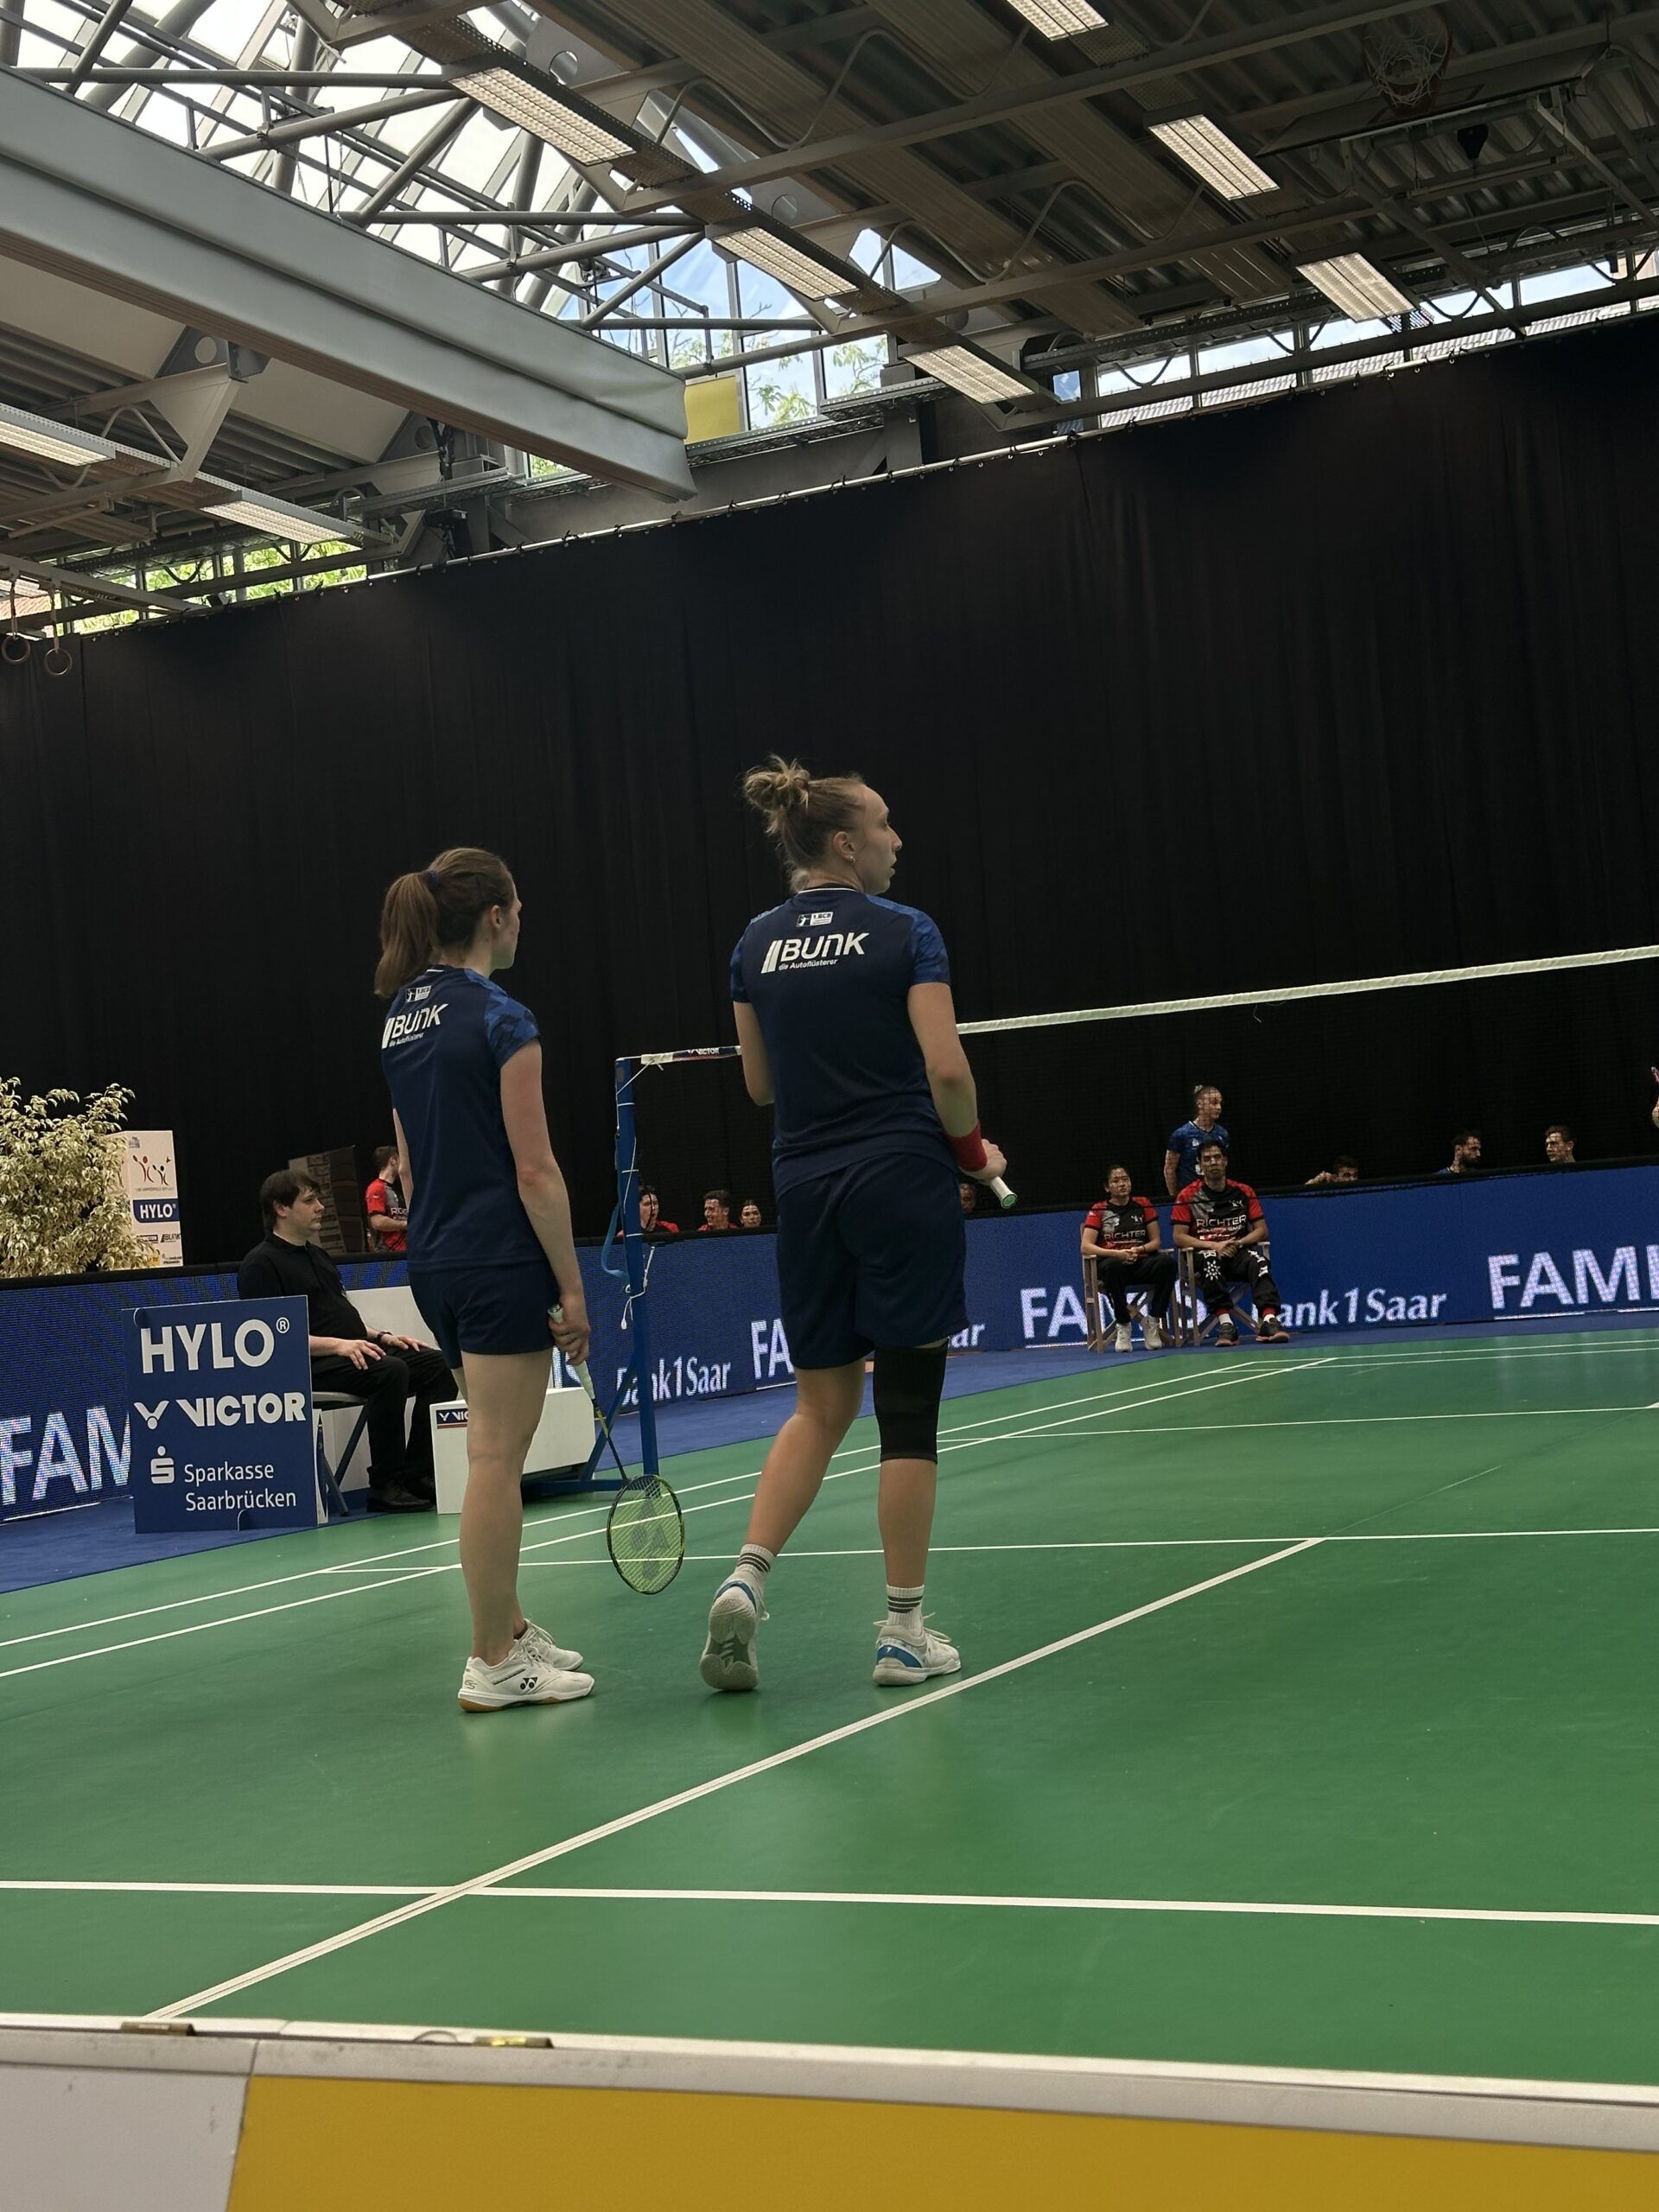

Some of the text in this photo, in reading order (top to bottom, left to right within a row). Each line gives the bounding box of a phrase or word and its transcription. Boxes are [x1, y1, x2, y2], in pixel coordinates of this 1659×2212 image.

[1196, 1214, 1247, 1227] RICHTER
[1103, 1230, 1146, 1239] RICHTER
[1488, 1244, 1659, 1309] FAMI
[175, 1392, 306, 1427] VICTOR
[451, 1411, 468, 1421] VIC
[0, 1405, 130, 1505] FAM
[184, 1461, 274, 1487] Sparkasse
[186, 1488, 296, 1511] Saarbrücken
